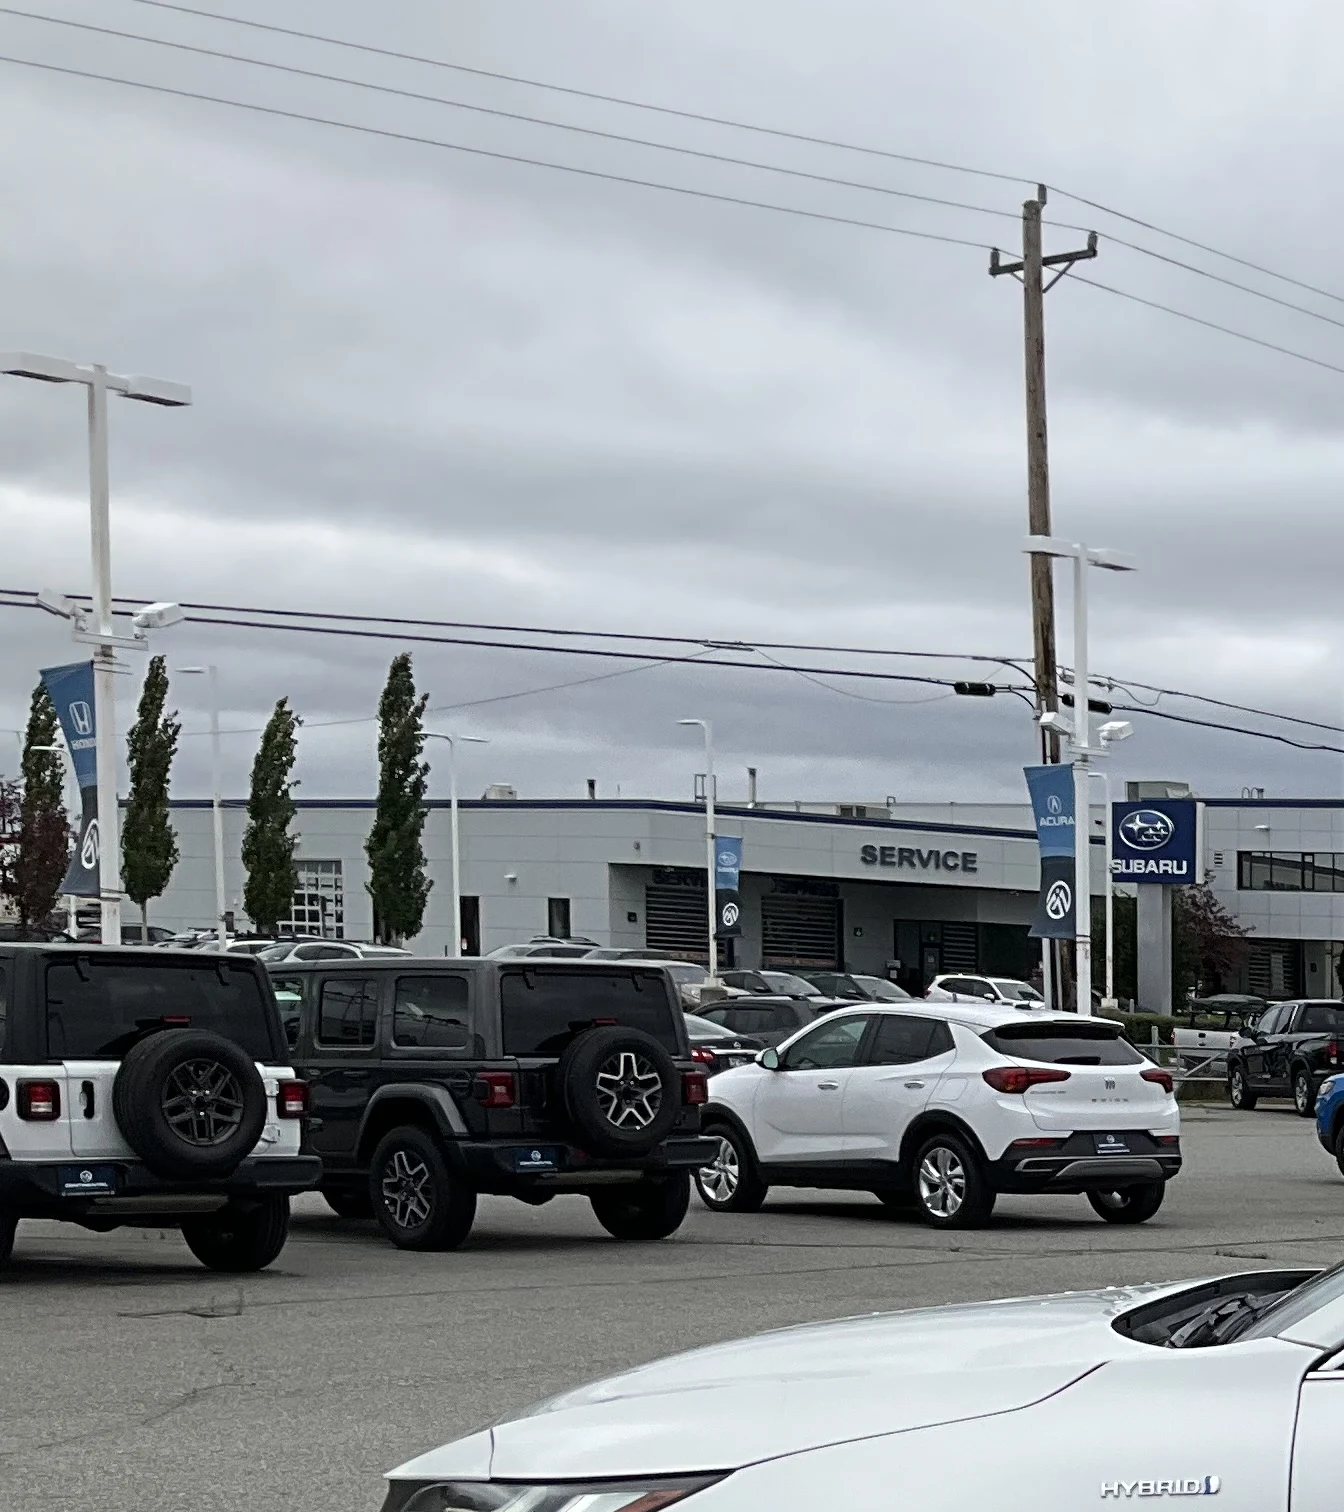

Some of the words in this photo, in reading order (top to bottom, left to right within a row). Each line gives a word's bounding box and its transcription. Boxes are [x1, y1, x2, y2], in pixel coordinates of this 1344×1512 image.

[1039, 816, 1075, 827] ACURA
[860, 844, 978, 873] SERVICE
[1111, 858, 1188, 875] SUBARU
[1100, 1479, 1201, 1498] HYBRID
